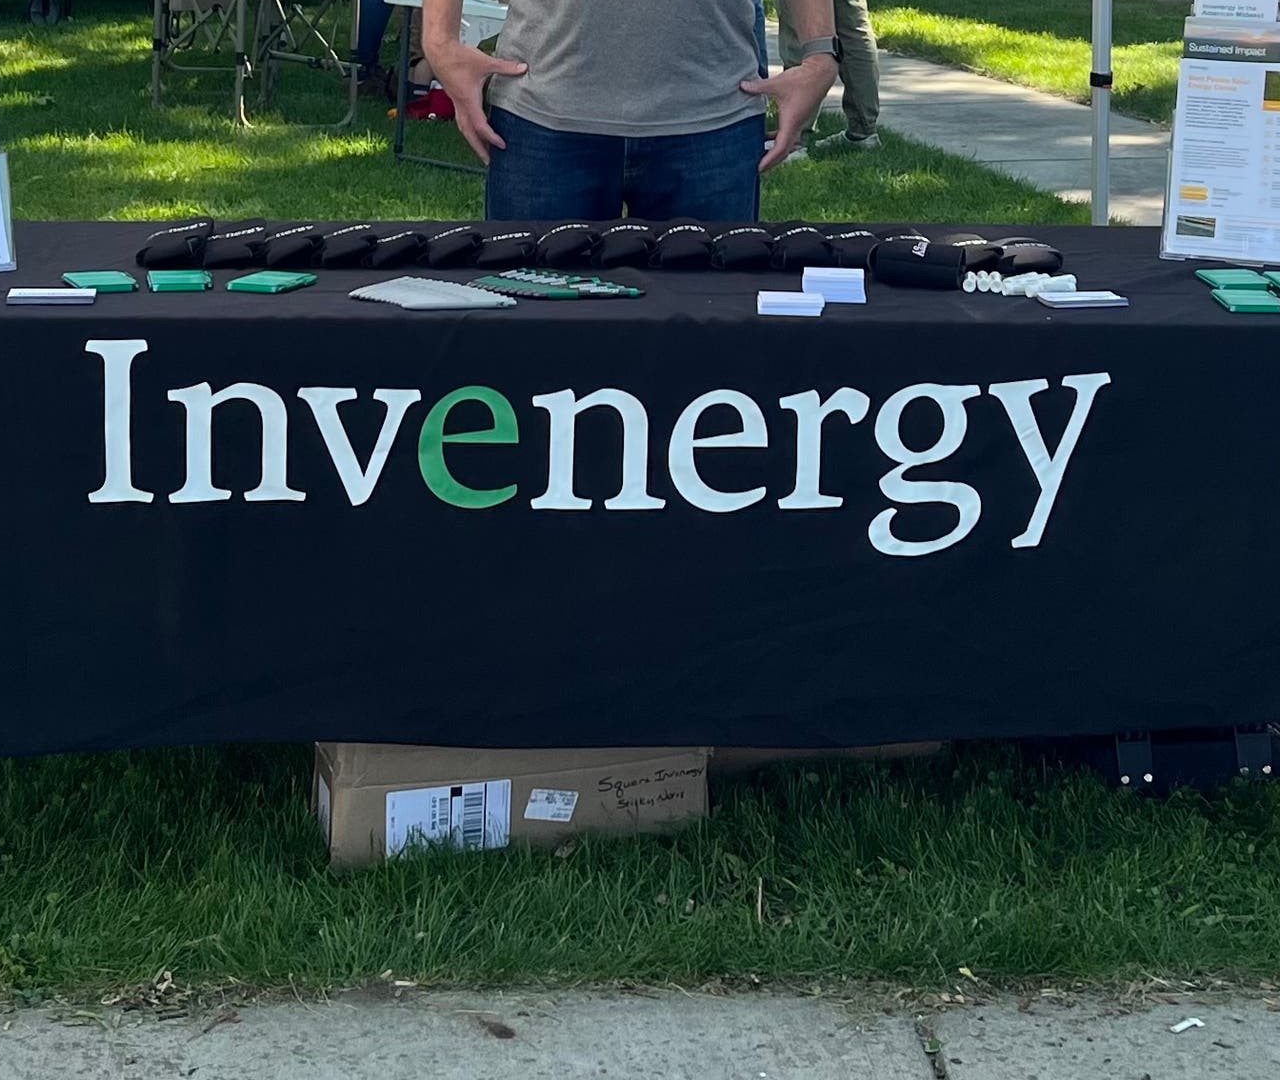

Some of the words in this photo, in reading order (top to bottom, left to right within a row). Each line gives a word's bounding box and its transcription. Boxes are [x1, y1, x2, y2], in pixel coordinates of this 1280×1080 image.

[1188, 42, 1234, 54] Sustained
[1235, 46, 1266, 56] Impact
[85, 338, 1111, 557] Invenergy
